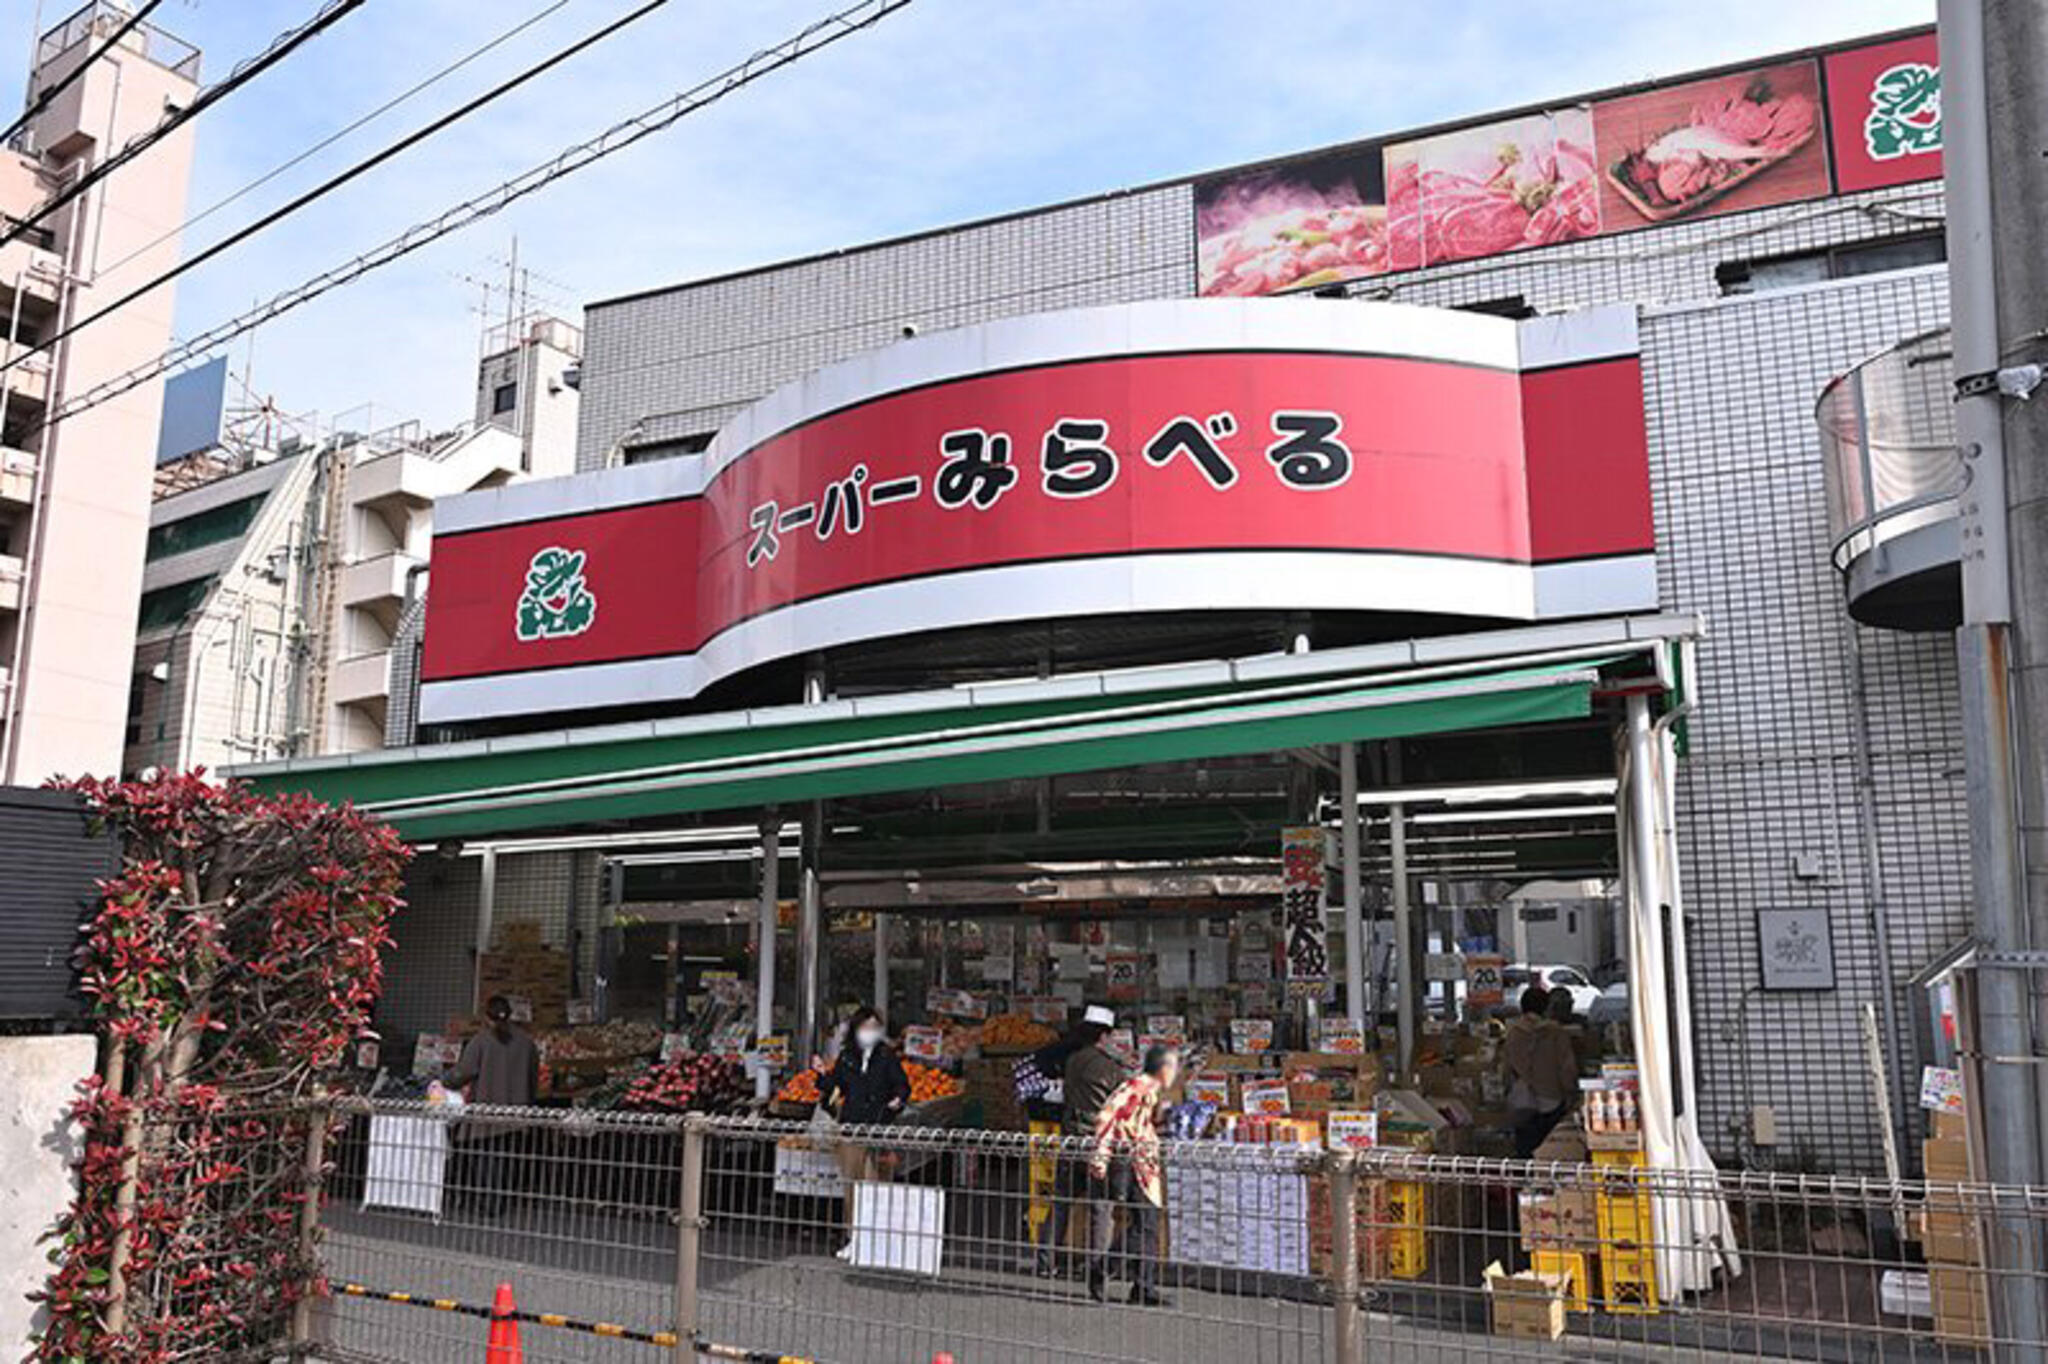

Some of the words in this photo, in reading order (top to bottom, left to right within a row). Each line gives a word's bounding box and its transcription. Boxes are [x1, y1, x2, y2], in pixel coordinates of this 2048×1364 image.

[747, 410, 1353, 568] スーパーみらべる
